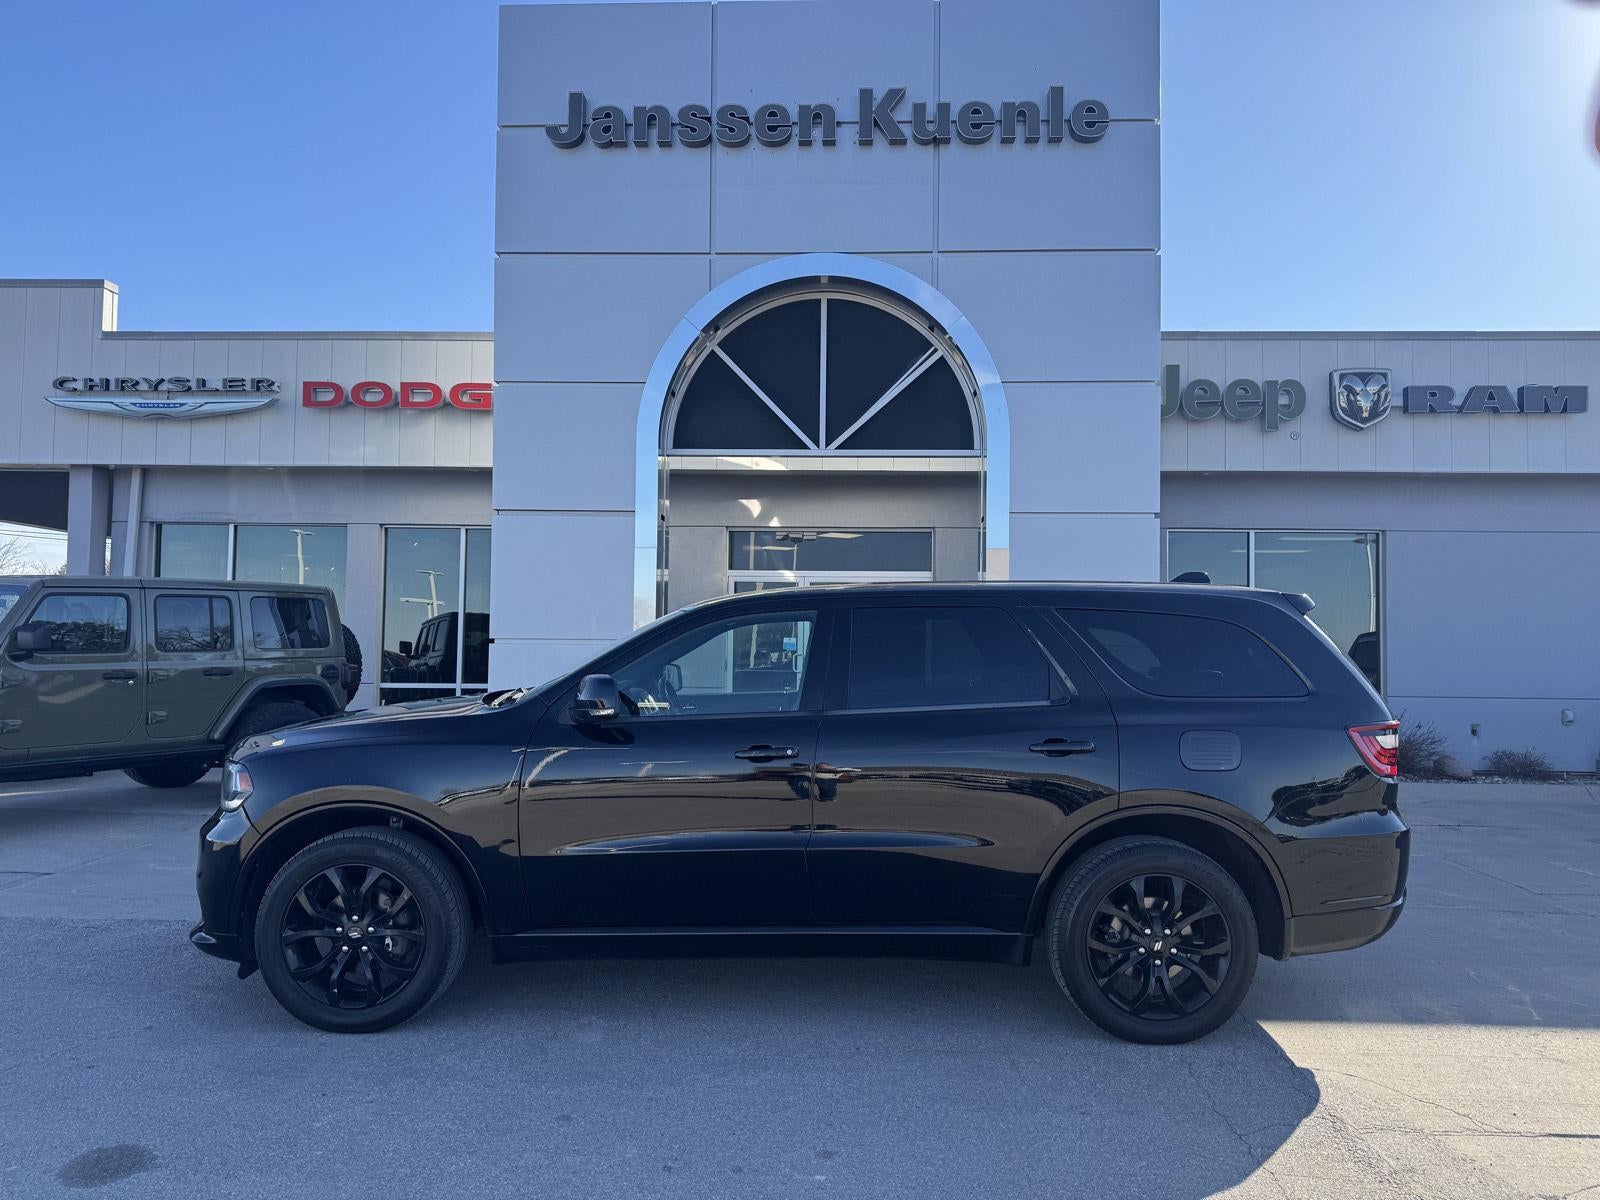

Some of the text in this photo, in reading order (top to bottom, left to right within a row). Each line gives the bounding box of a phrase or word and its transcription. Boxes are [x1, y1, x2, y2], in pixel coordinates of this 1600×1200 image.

[545, 85, 1111, 149] Janssen Kuenle
[52, 377, 278, 391] CHRYSLER
[1161, 364, 1307, 431] Jeep
[1402, 384, 1589, 414] RAM
